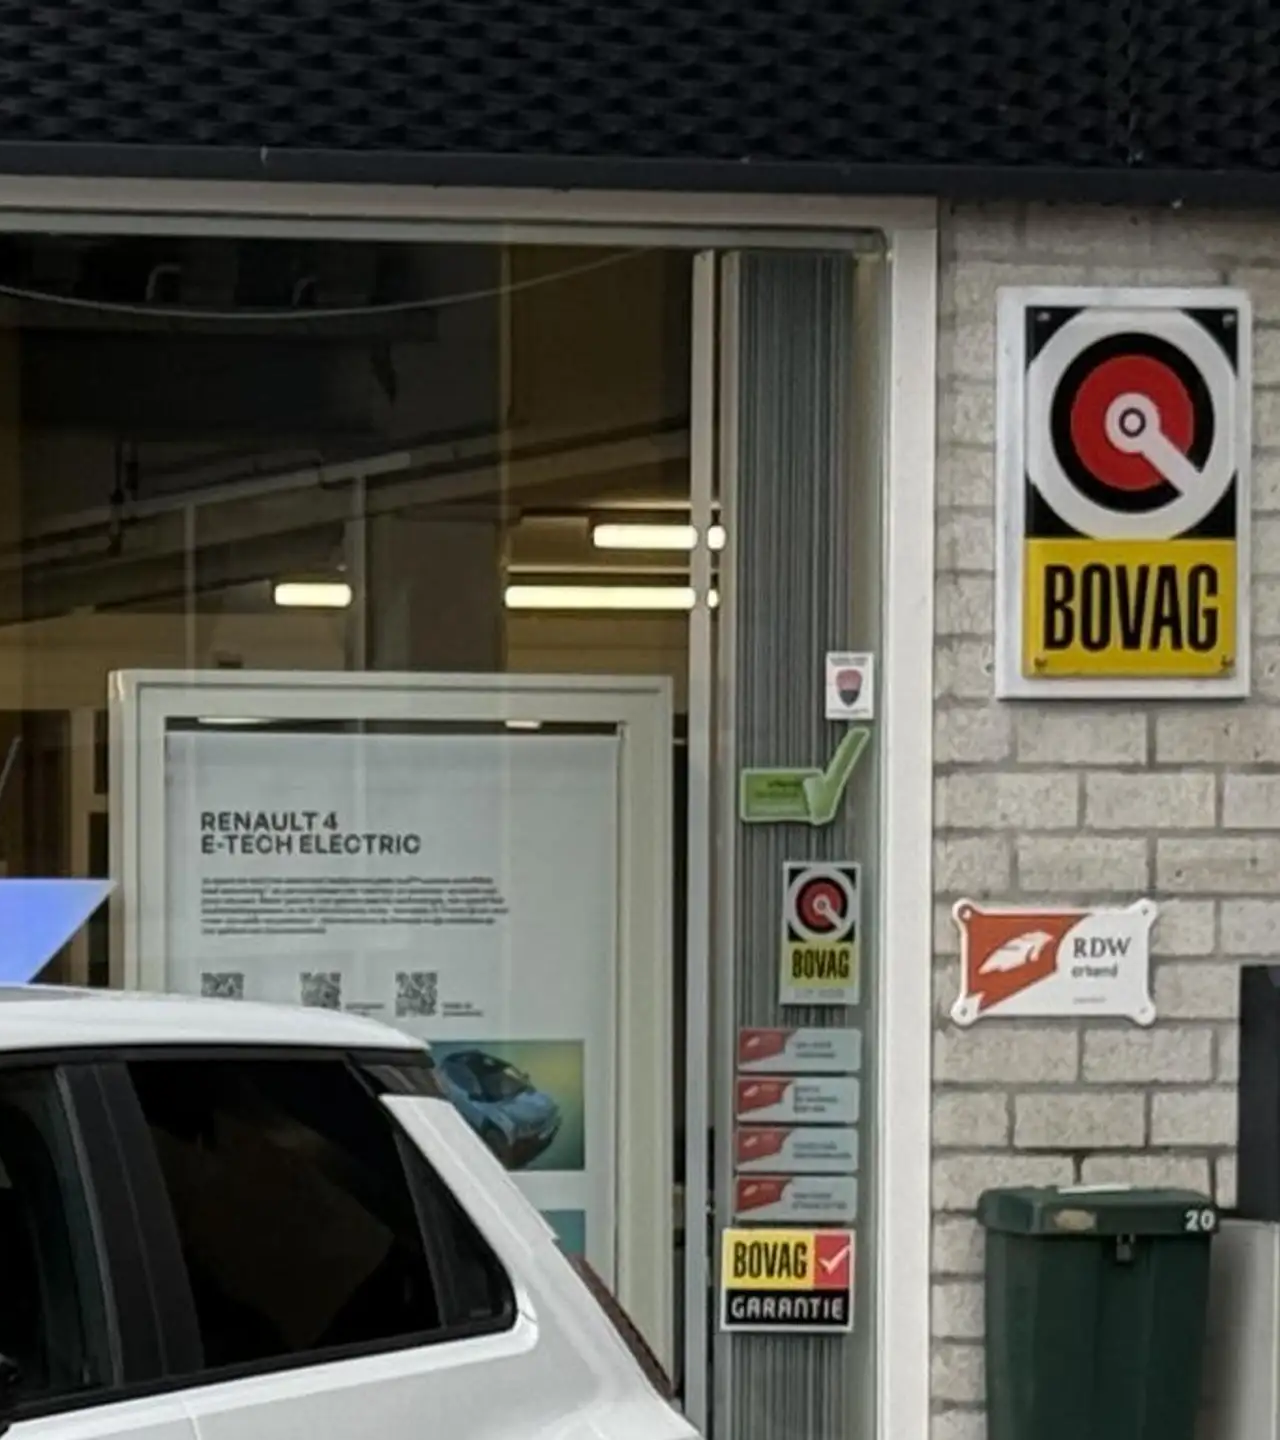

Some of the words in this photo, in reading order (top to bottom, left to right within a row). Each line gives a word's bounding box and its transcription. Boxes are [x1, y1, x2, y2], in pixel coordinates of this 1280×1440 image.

[1043, 563, 1218, 652] BOVAG
[200, 811, 318, 831] RENAULT
[322, 811, 338, 830] 4
[201, 834, 292, 854] E-TECH
[299, 833, 421, 854] ELECTRIC
[1073, 937, 1131, 958] RDW
[792, 948, 850, 979] BOVAG
[1185, 1210, 1215, 1230] 20
[733, 1241, 807, 1278] BOVAG
[731, 1296, 843, 1319] GARANTIE
